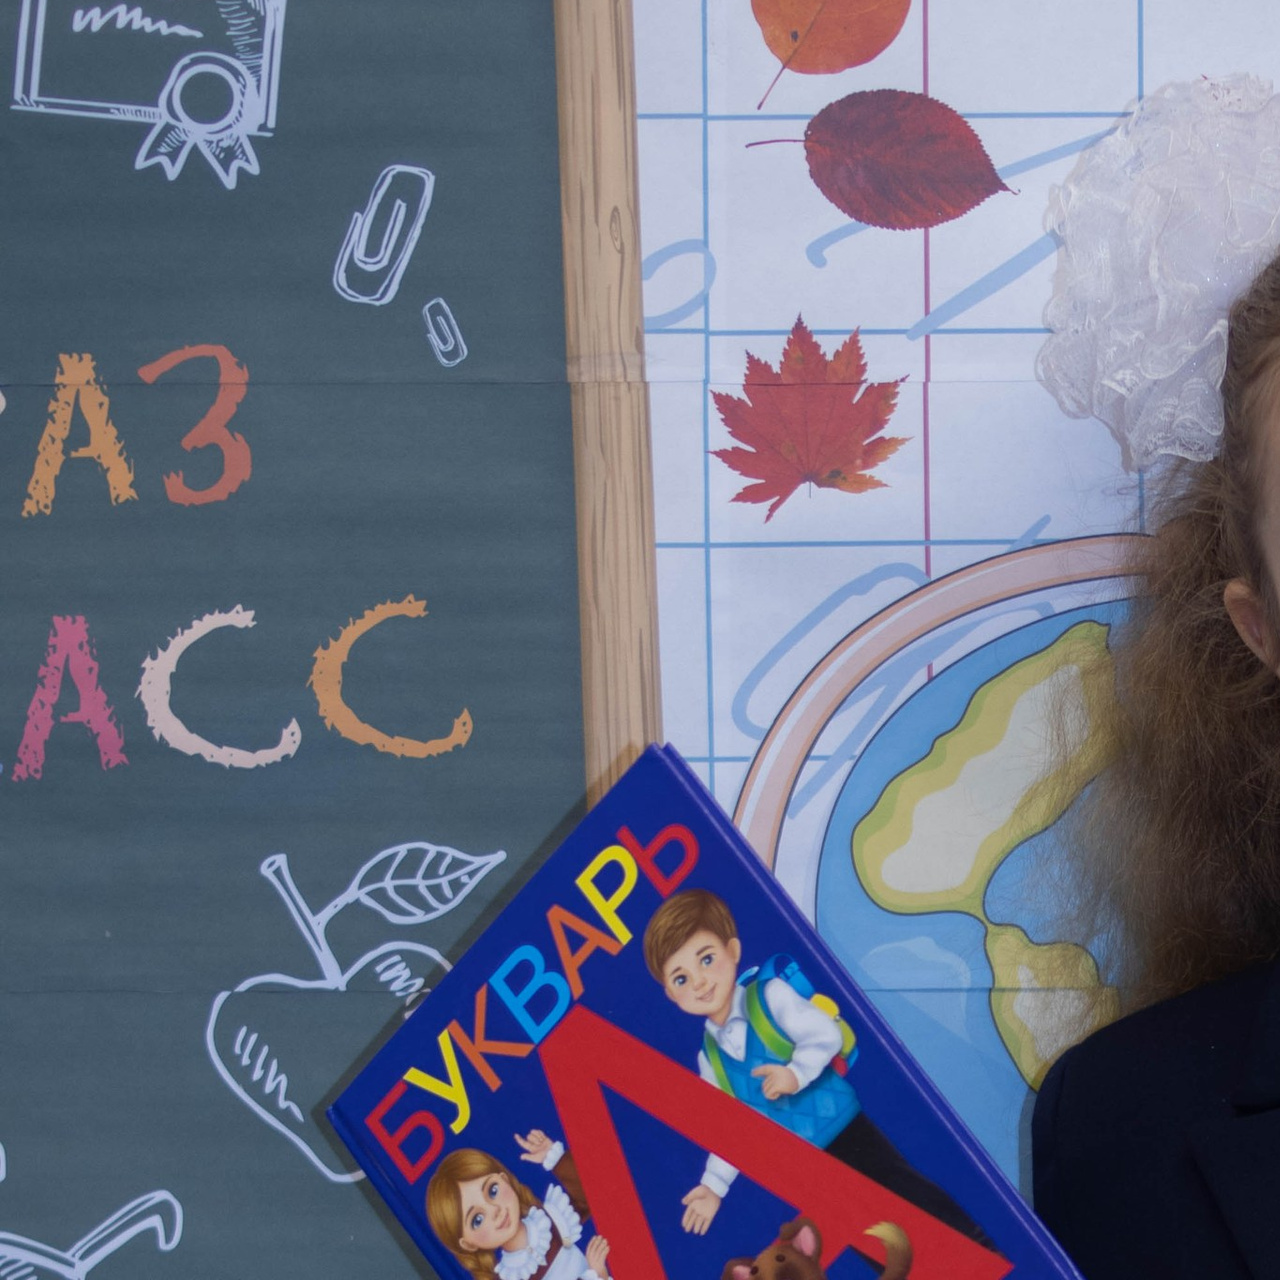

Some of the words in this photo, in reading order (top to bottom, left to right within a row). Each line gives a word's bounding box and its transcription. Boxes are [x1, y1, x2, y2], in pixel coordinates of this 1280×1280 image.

[0, 344, 253, 518] АЗ
[0, 594, 473, 782] АСС
[365, 823, 700, 1184] БУКВАРЬ
